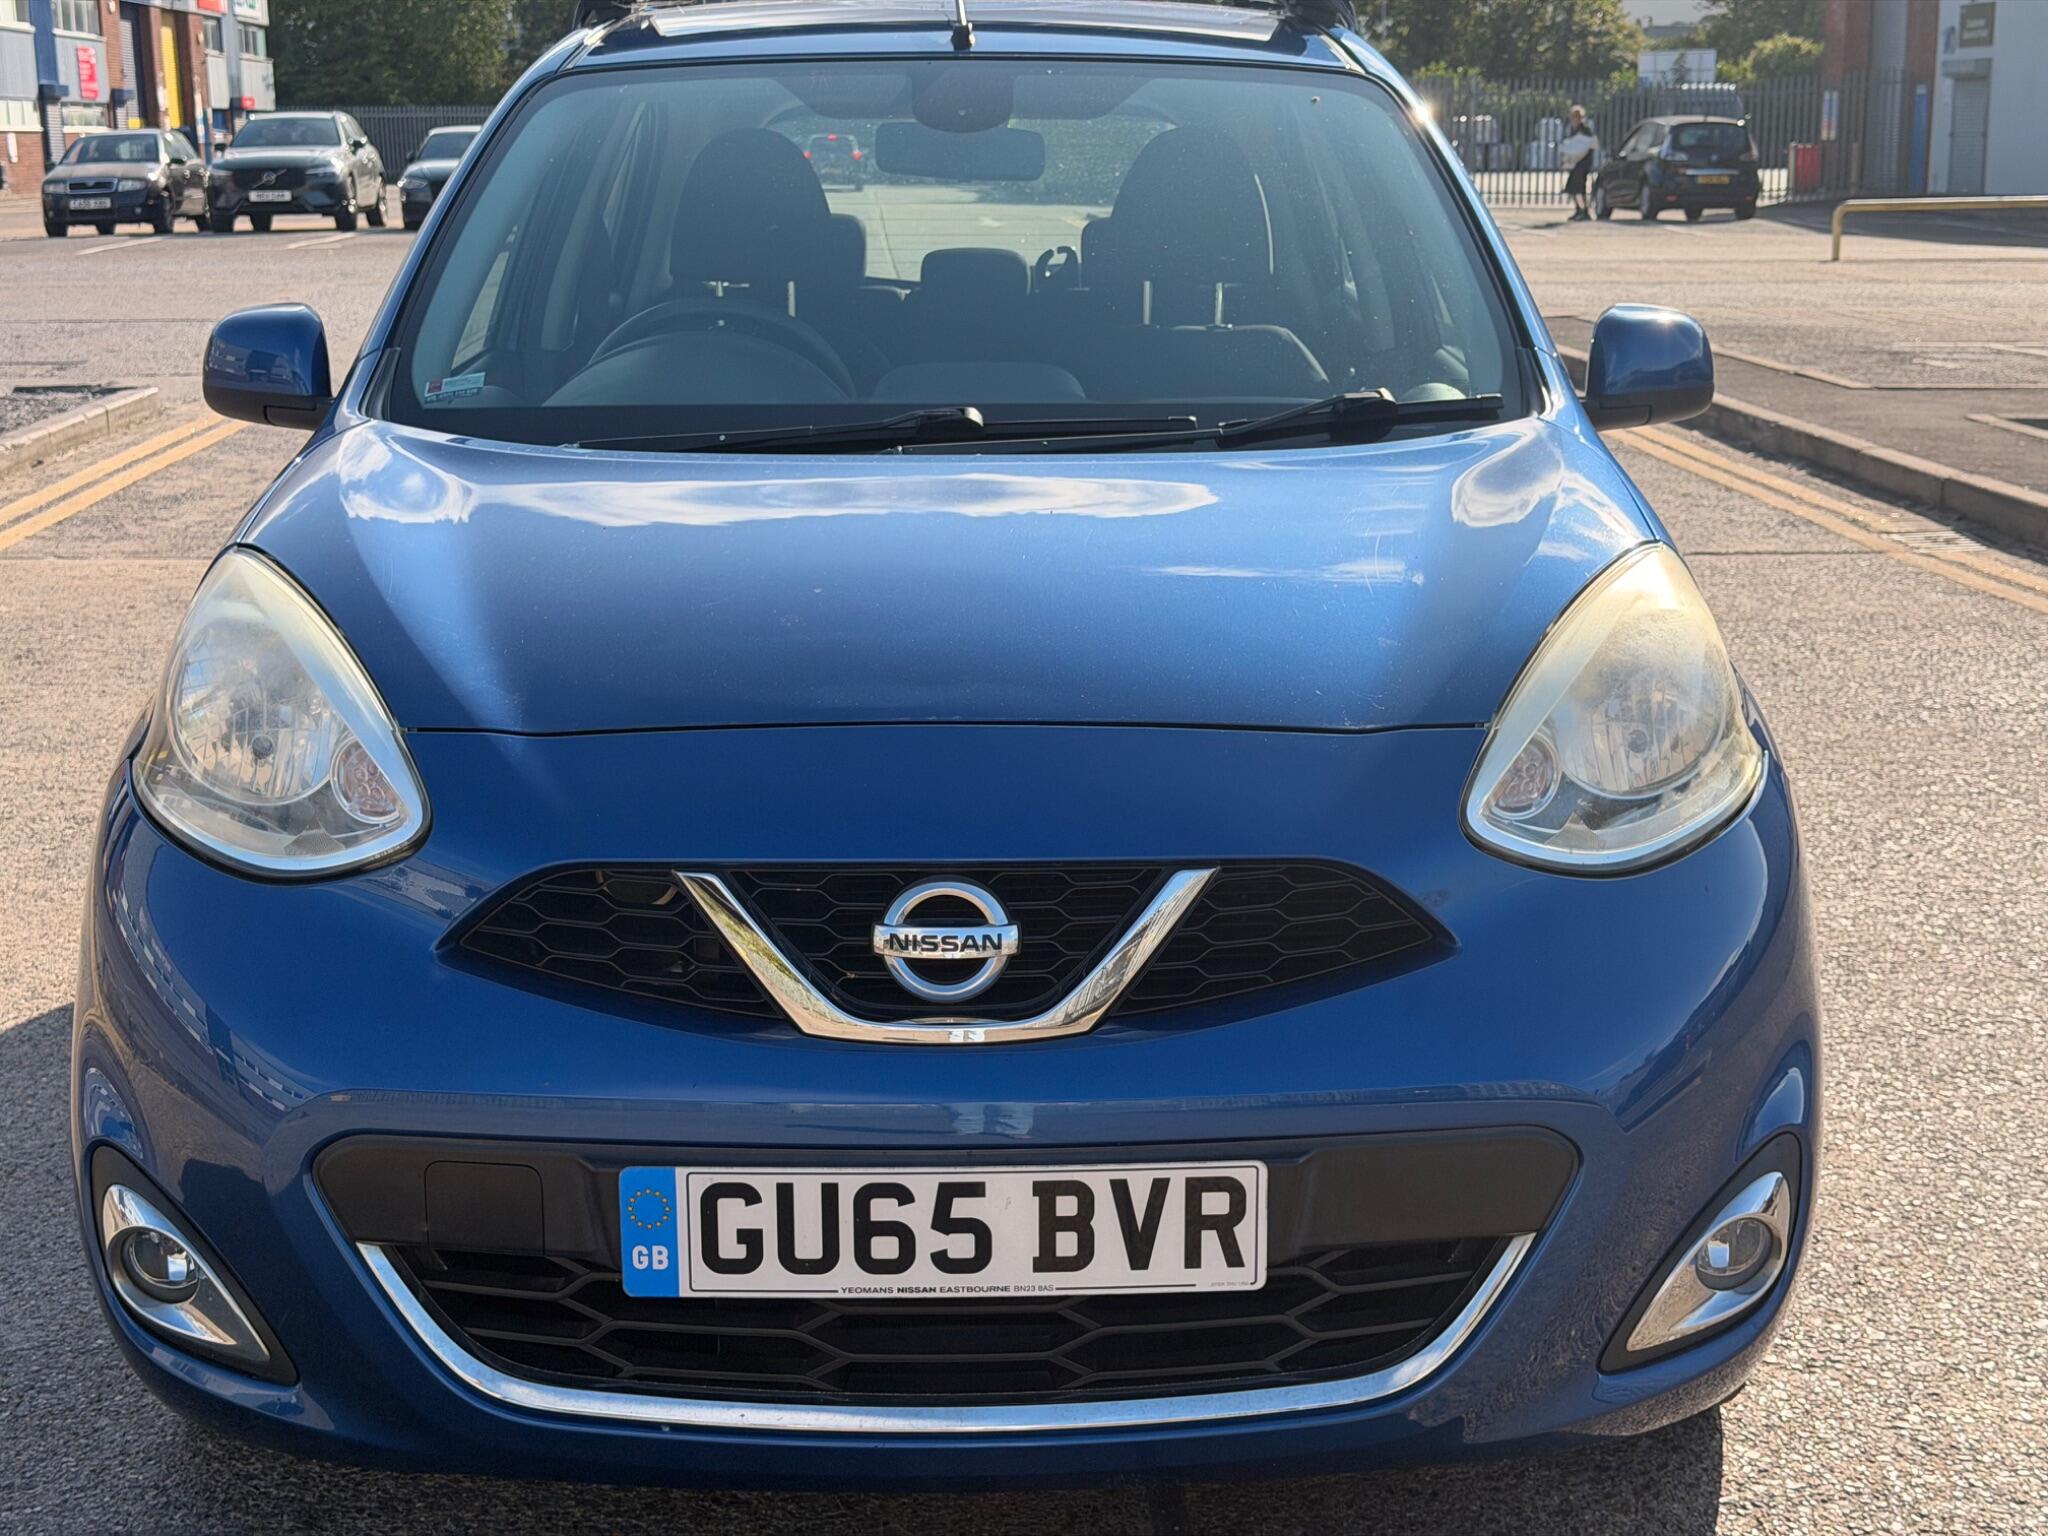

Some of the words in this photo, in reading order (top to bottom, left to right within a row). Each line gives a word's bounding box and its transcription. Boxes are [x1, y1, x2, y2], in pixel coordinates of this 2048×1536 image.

[889, 932, 1003, 953] NISSAN
[699, 1181, 993, 1275] GU65
[1032, 1175, 1248, 1273] BVR
[631, 1244, 670, 1271] GB
[840, 1286, 894, 1294] YEOMANS
[896, 1286, 937, 1294] NISSAN
[939, 1285, 1011, 1293] EASTBOURNE
